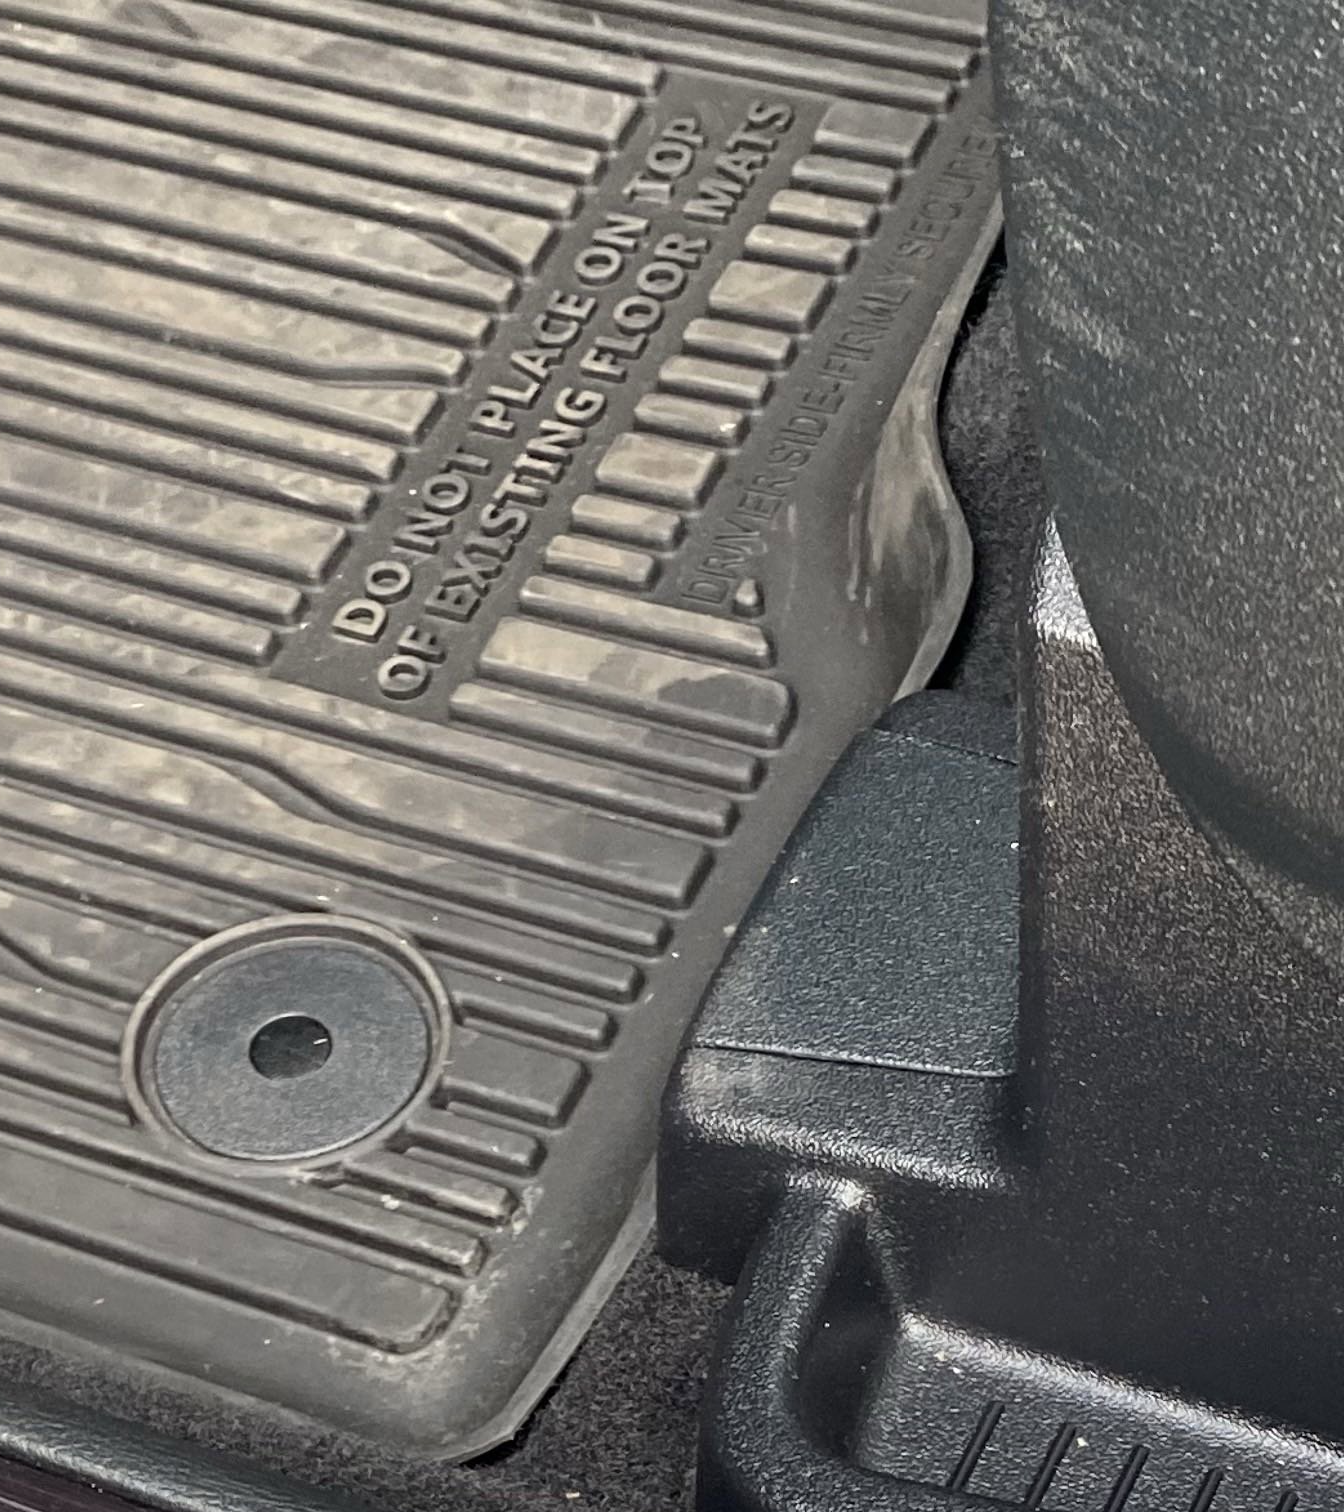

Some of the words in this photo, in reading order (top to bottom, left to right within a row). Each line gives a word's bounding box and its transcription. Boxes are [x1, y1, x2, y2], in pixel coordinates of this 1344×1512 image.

[332, 560, 411, 641] DO
[396, 449, 490, 558] NOT
[472, 290, 598, 435] PLACE
[576, 211, 649, 287] ON
[623, 115, 705, 204] TOP
[378, 626, 446, 699] OF
[427, 387, 604, 624] EXISTING
[583, 232, 709, 382] FLOOR
[685, 101, 794, 224] MATS
[681, 474, 796, 604] DRIVER
